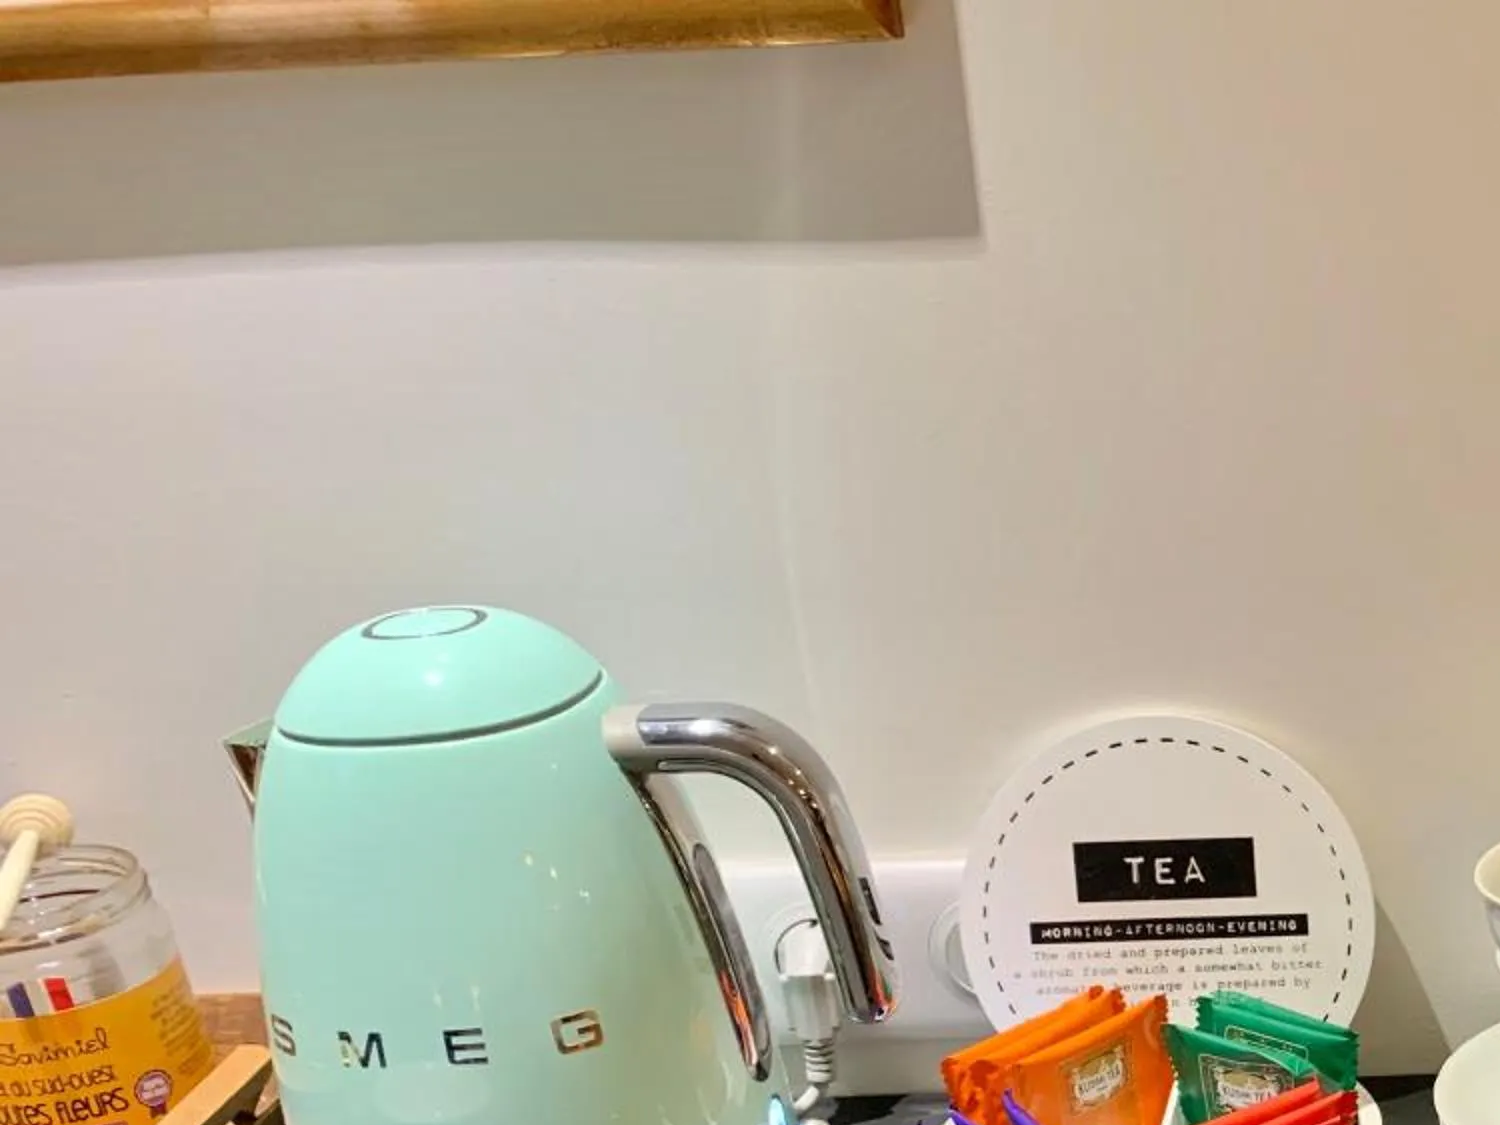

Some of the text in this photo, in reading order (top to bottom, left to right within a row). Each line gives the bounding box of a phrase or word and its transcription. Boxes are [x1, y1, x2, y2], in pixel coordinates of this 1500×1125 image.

[1122, 855, 1206, 886] TEA
[1040, 919, 1298, 939] MORNING-AFTERNOON-EVENING
[1034, 942, 1308, 961] The dried and prepared leaves of
[1031, 966, 1074, 979] shrub
[1083, 965, 1118, 977] from
[1125, 963, 1168, 975] which
[1194, 961, 1263, 973] somewhat
[1271, 959, 1323, 971] bitter
[1193, 980, 1208, 991] is
[1217, 976, 1286, 990] prepared
[1293, 975, 1312, 989] by
[271, 1009, 604, 1069] SMEG
